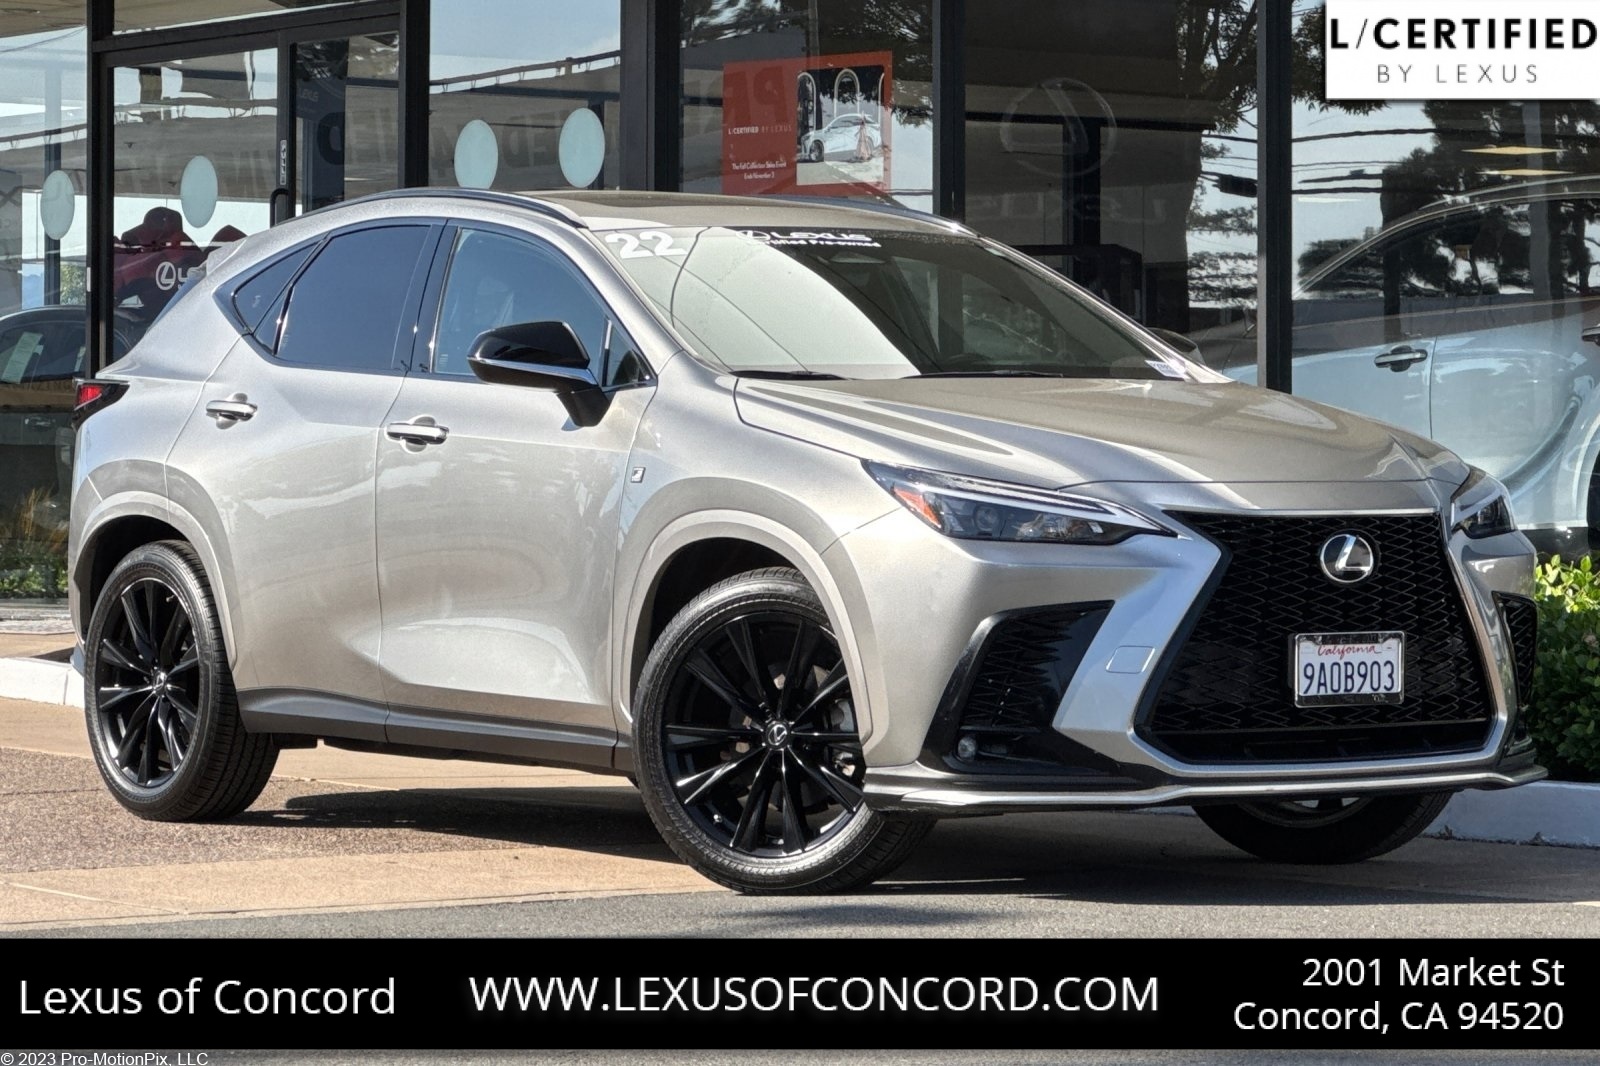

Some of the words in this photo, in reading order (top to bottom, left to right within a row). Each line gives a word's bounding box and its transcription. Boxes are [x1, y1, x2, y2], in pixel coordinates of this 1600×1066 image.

[604, 231, 689, 259] 22
[770, 231, 872, 241] LEXUS
[1317, 644, 1382, 661] California
